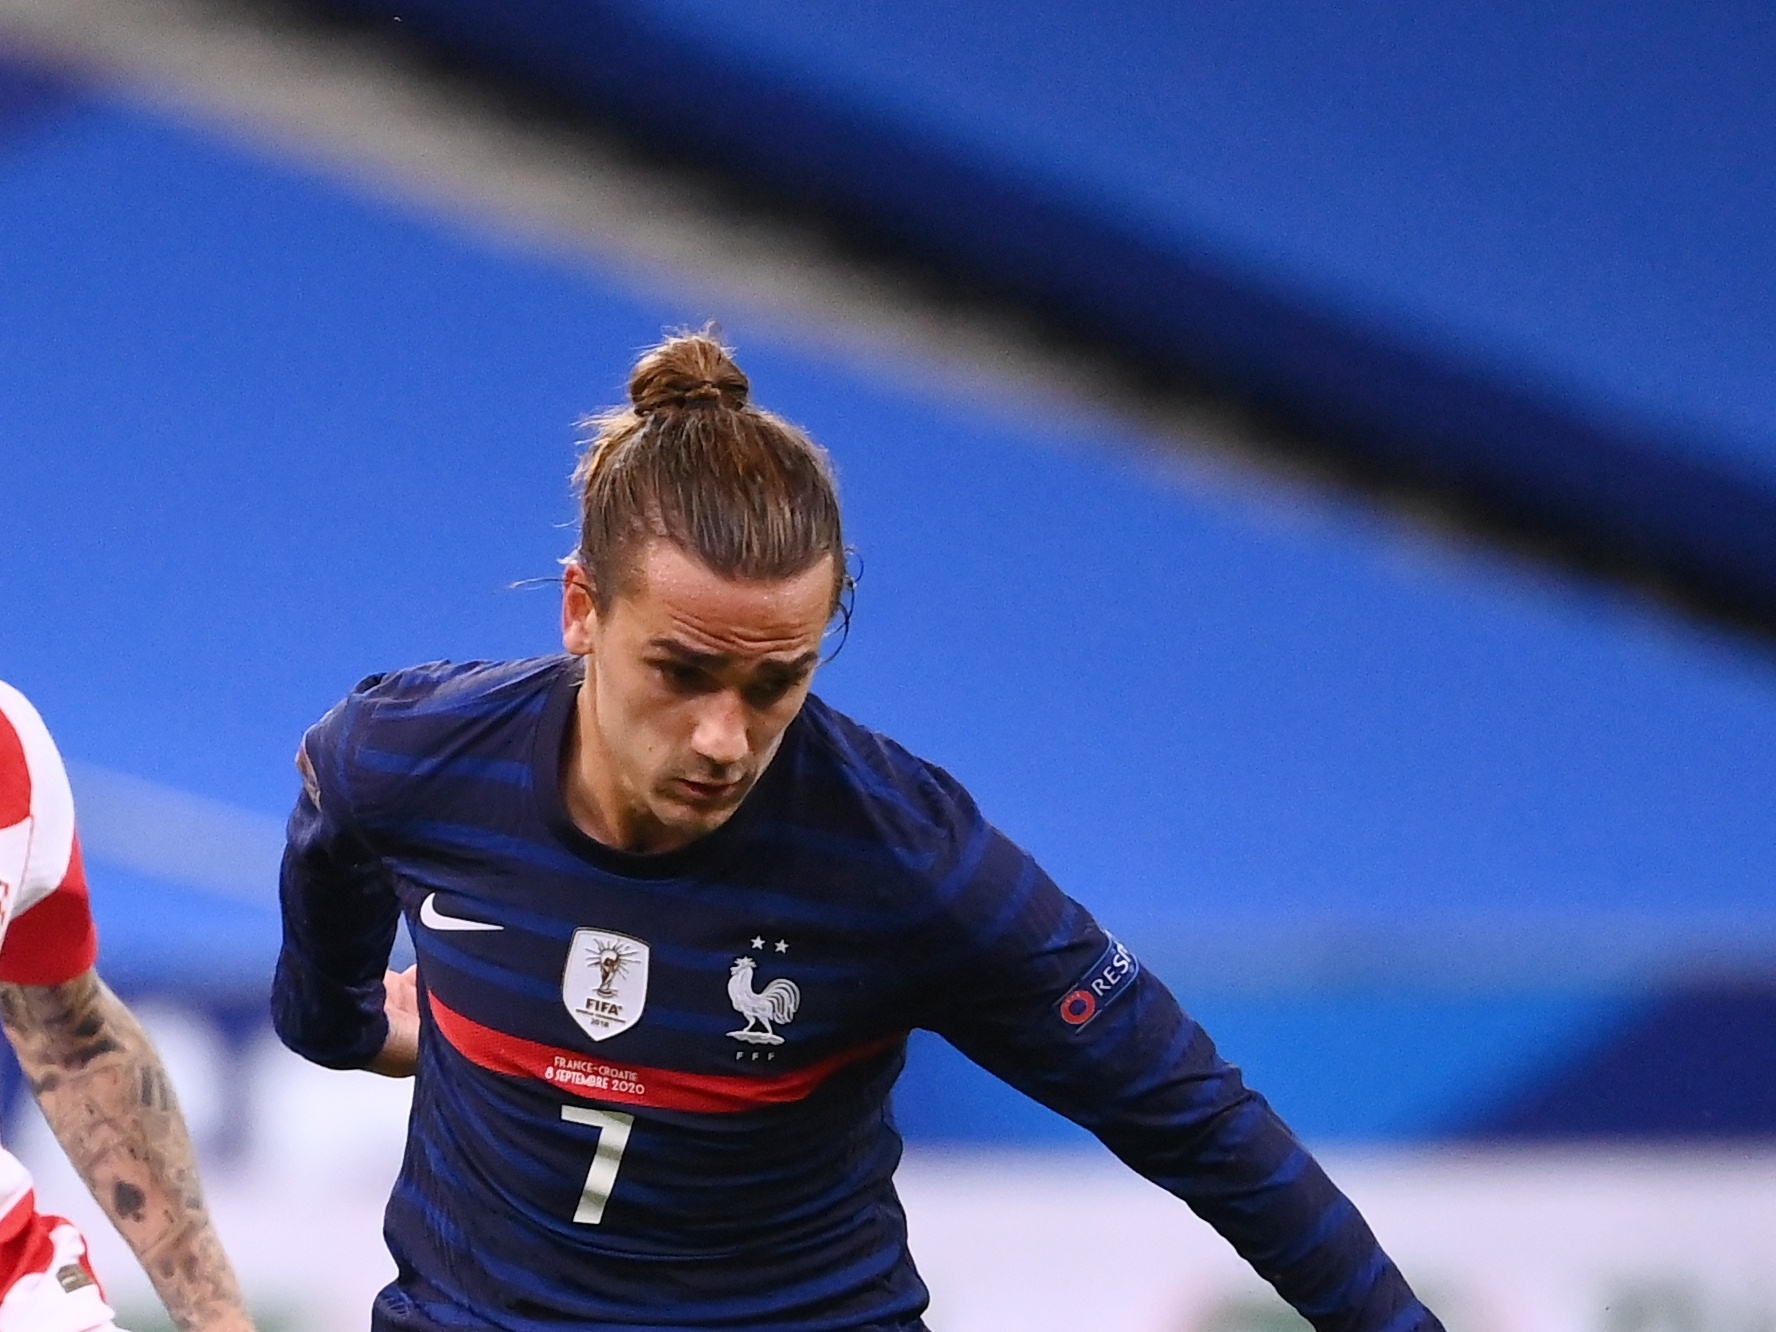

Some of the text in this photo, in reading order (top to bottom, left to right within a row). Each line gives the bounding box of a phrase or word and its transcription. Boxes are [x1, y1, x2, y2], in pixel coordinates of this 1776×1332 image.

[545, 1066, 645, 1095] 8 SEPTEMBRE 2020
[561, 1104, 635, 1225] 7
